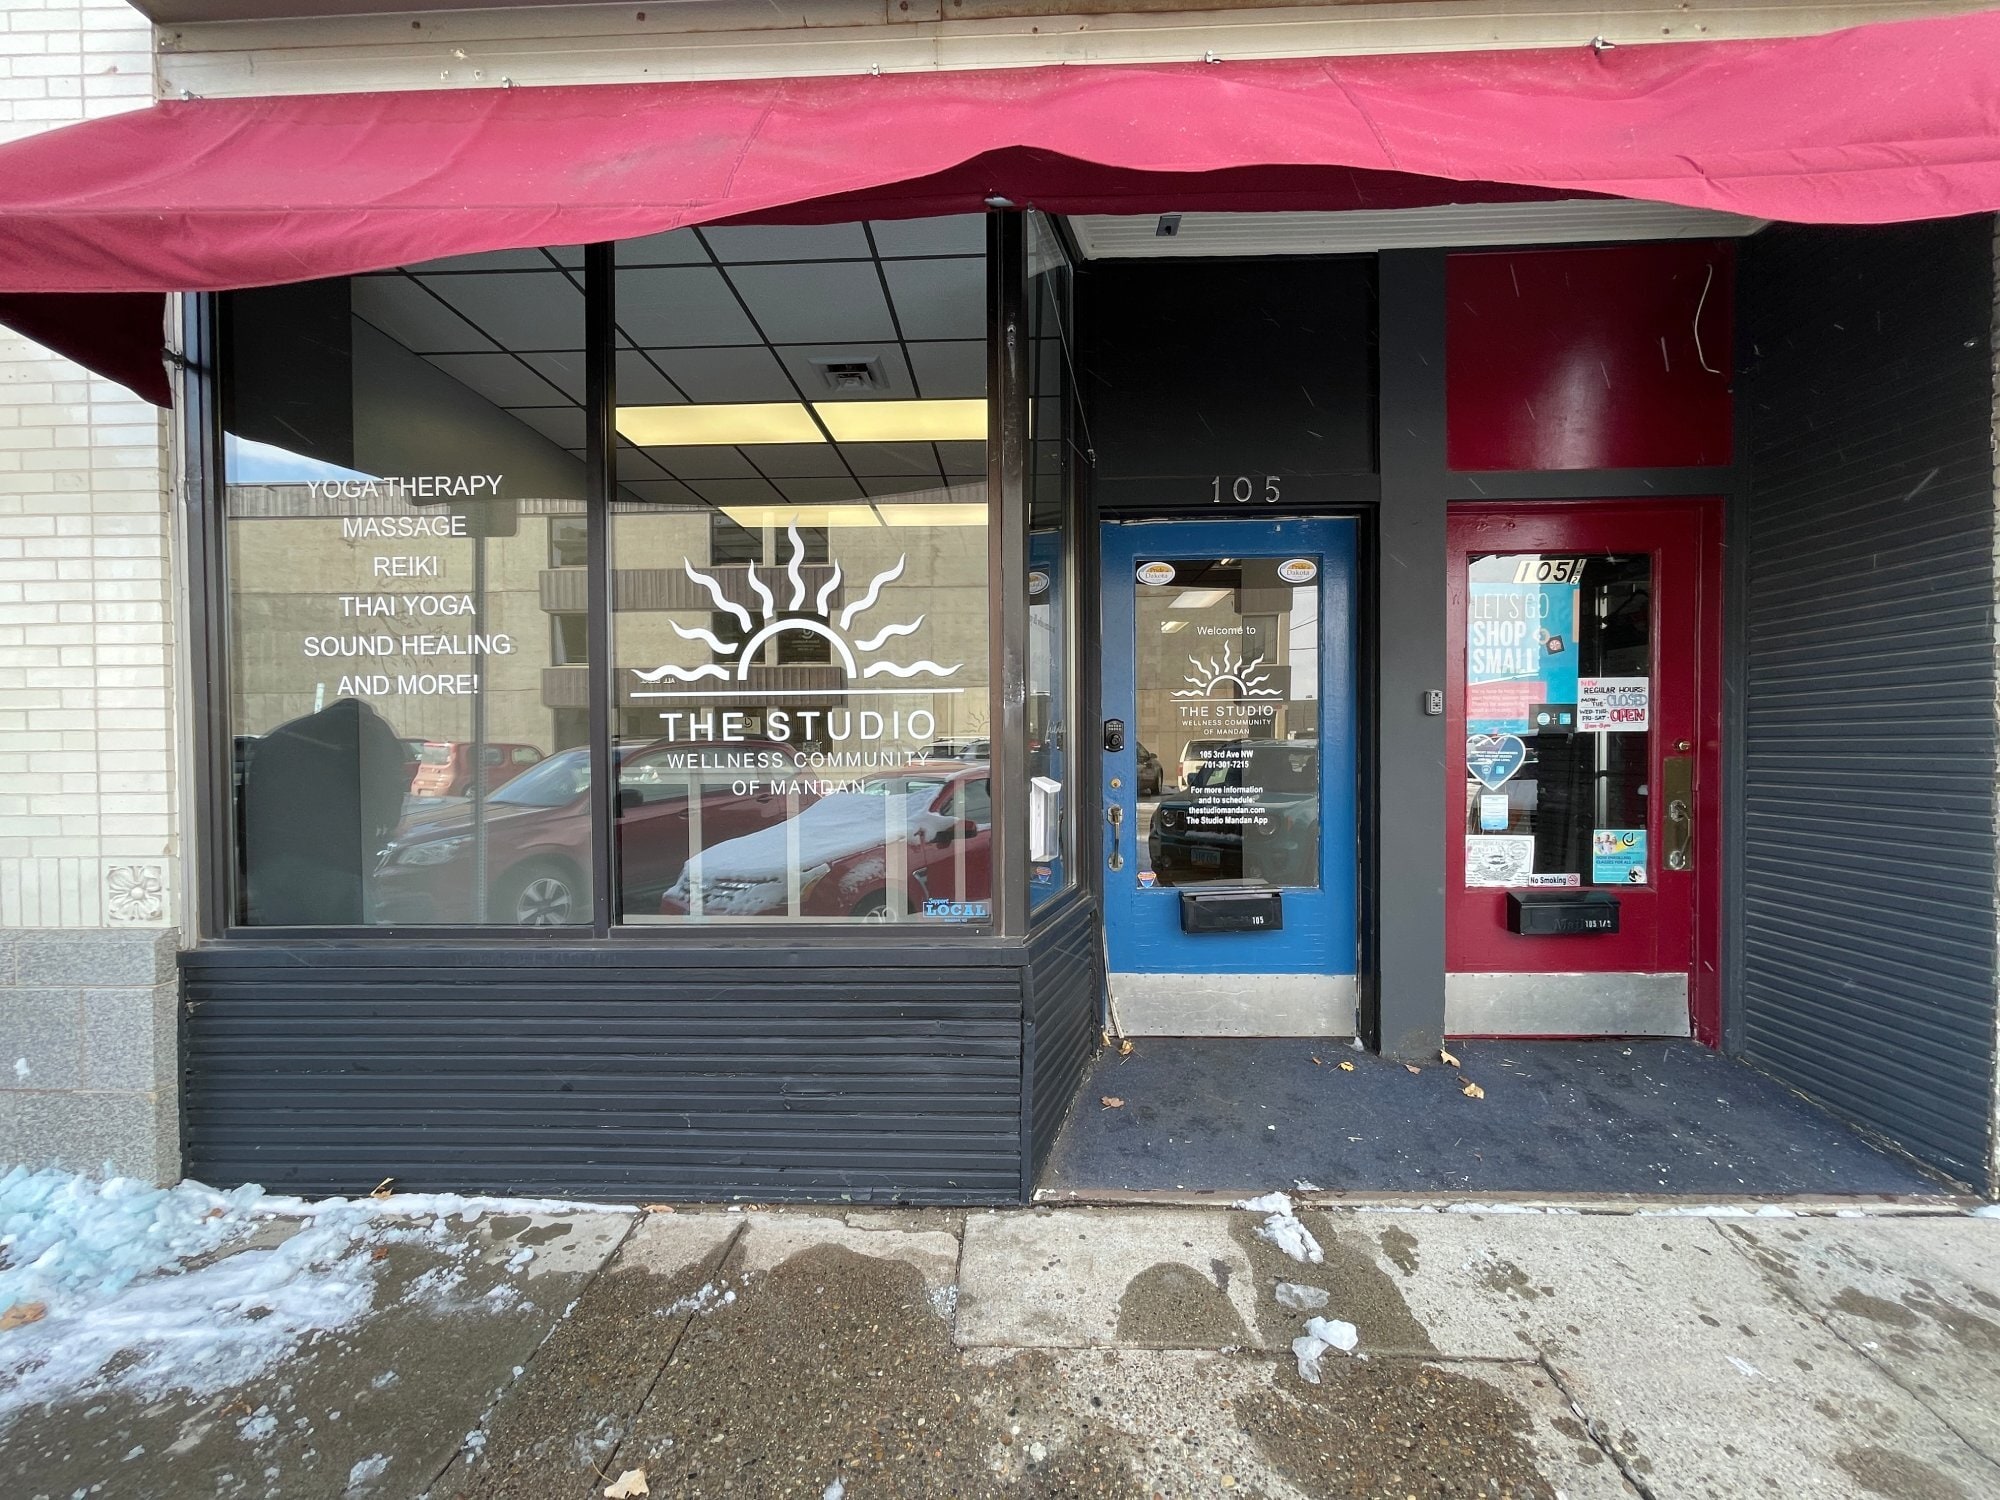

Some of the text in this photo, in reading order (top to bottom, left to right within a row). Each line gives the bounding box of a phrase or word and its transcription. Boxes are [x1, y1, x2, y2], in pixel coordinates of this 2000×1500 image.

[307, 475, 503, 498] YOGA THERAPY
[1211, 476, 1281, 502] 105
[343, 516, 467, 537] MASSAGE
[374, 556, 438, 577] REIKI
[1520, 561, 1570, 581] 105
[339, 595, 477, 616] THAI YOGA
[1474, 593, 1550, 619] LET'S GO
[1197, 626, 1256, 635] Welcome to
[1473, 620, 1527, 647] SHOP
[304, 634, 511, 656] SOUND HEALING
[1472, 647, 1537, 674] SMALL
[337, 674, 479, 695] AND MORE!
[1583, 686, 1616, 694] REGULAR
[1606, 693, 1648, 707] CLOSED
[1180, 705, 1274, 717] THE STUDIO
[1609, 708, 1646, 722] OPEN
[659, 710, 936, 742] THE STUDIO
[1182, 719, 1222, 727] WELLNESS
[667, 751, 930, 769] WELLNESS COMMUNITY
[1199, 750, 1254, 758] 105 3rd Ave NW
[732, 779, 866, 796] OF MANDAN
[1190, 786, 1202, 794] For
[1198, 796, 1212, 804] and
[1213, 796, 1220, 804] to
[1188, 806, 1266, 814] thestudiomandan.com
[1186, 816, 1269, 825] The Studio Mandan App
[1530, 876, 1539, 884] No
[1539, 876, 1567, 886] Smoking
[925, 904, 986, 916] LOCAL
[1252, 915, 1264, 925] 105
[1585, 920, 1612, 928] 105 1/2
